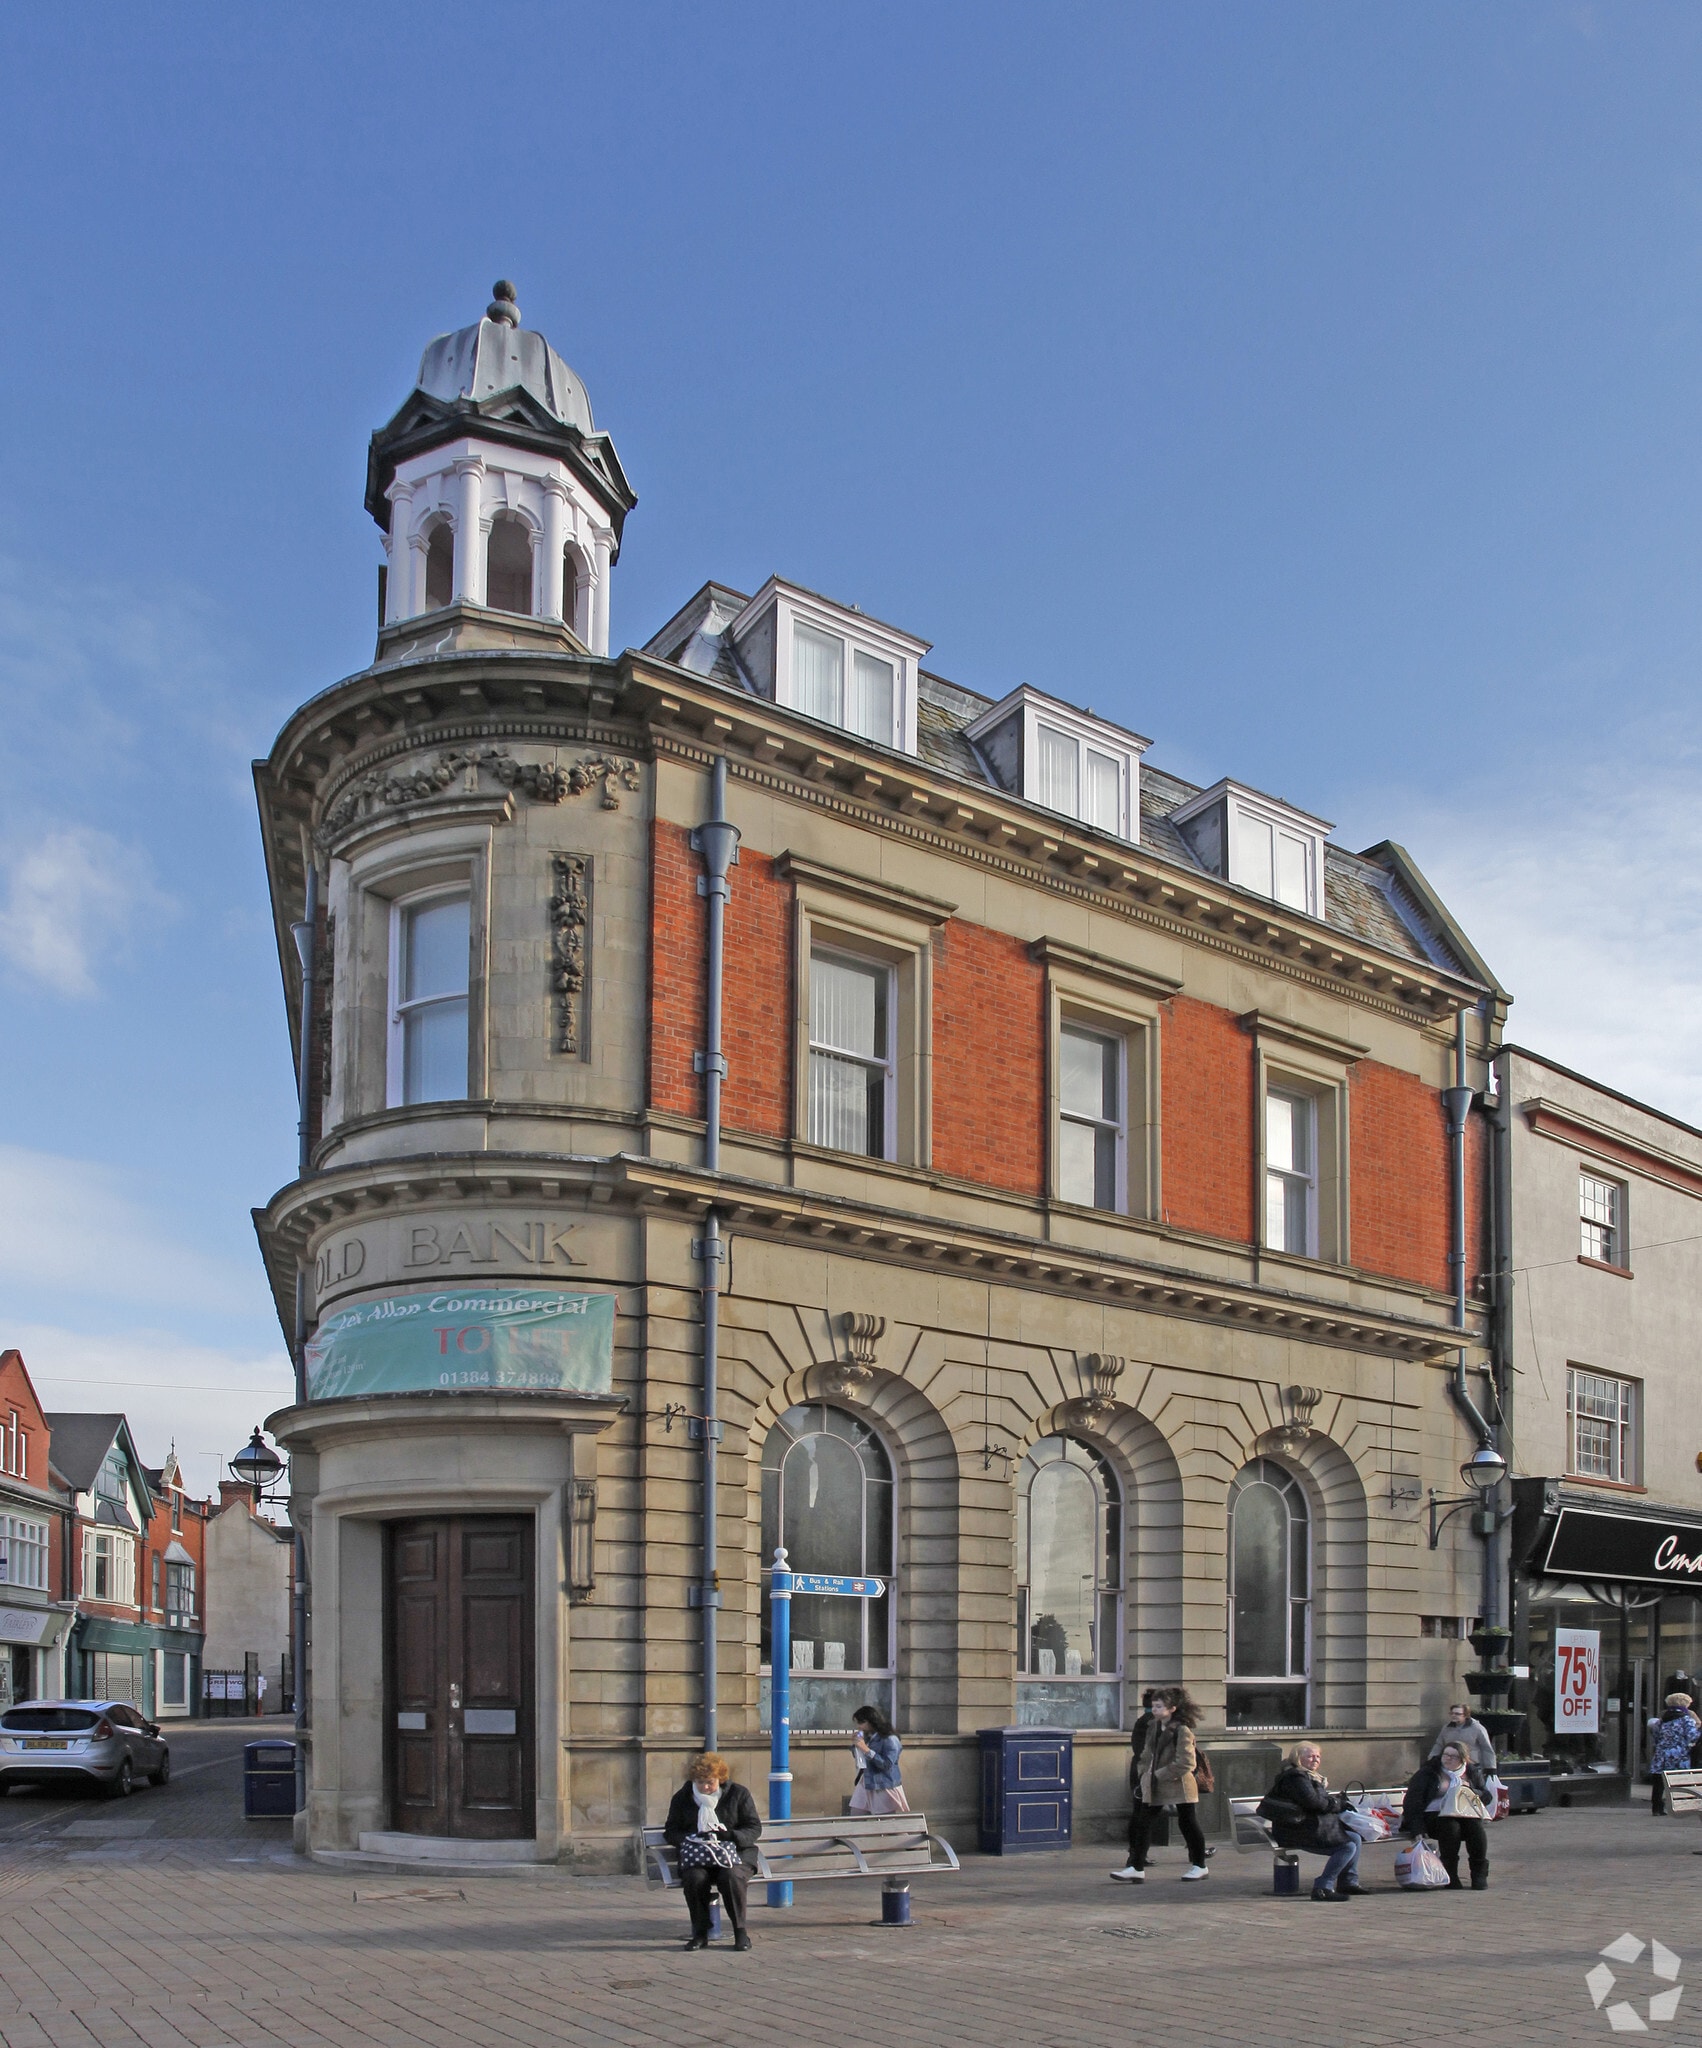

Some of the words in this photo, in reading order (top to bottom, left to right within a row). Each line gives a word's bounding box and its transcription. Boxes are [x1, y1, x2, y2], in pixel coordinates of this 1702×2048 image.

[315, 1238, 366, 1295] OLD
[403, 1221, 588, 1268] BANK
[427, 1295, 589, 1315] Commercial
[433, 1325, 491, 1354] TO
[440, 1371, 490, 1385] 01384
[495, 1370, 561, 1384] 374888
[1558, 1646, 1598, 1696] 75%
[1563, 1698, 1592, 1717] OFF
